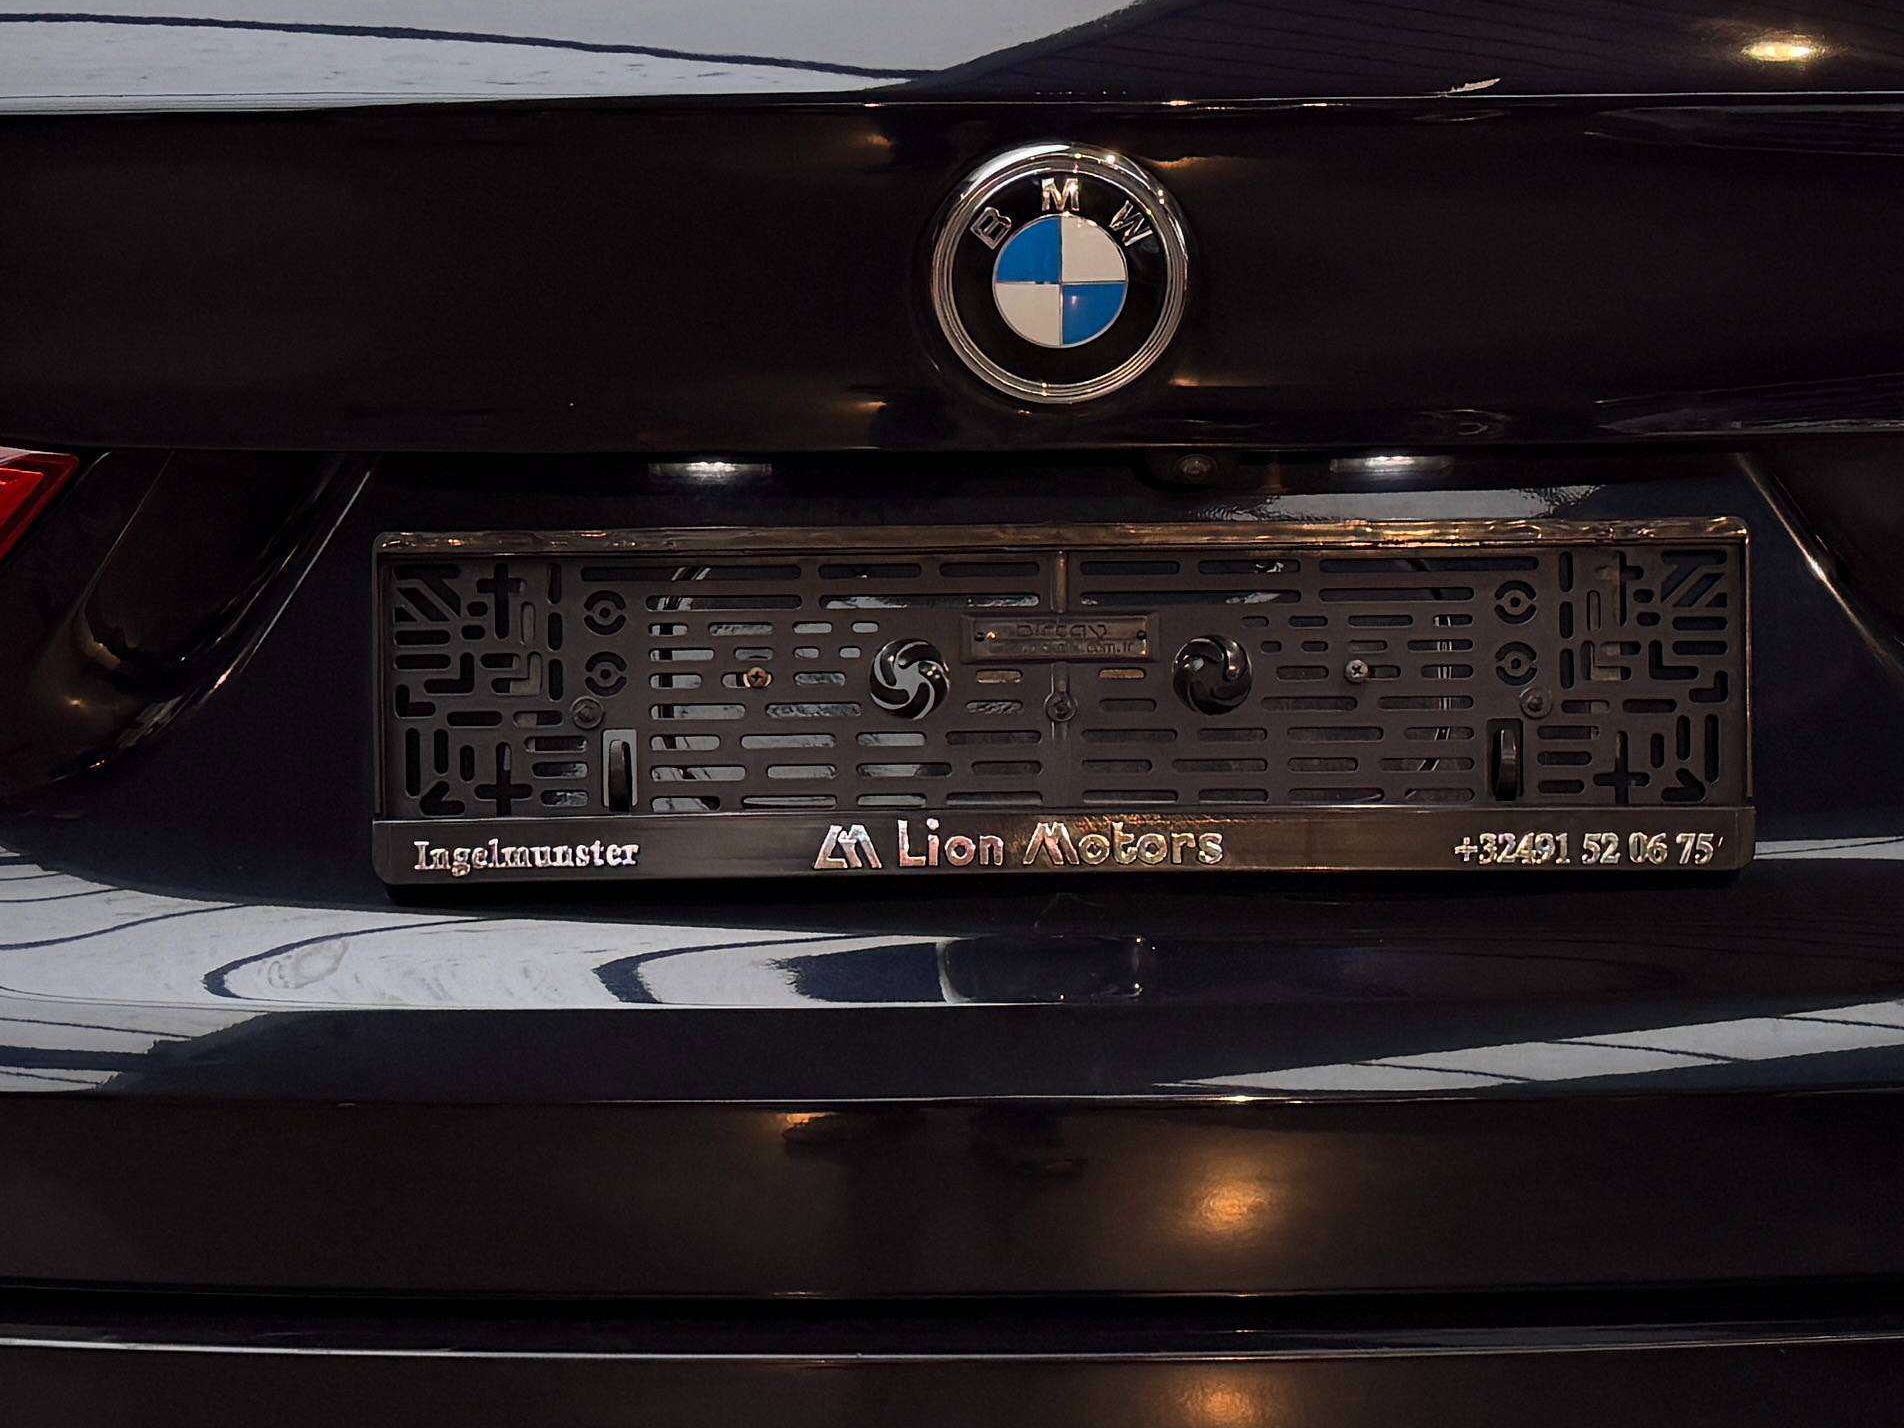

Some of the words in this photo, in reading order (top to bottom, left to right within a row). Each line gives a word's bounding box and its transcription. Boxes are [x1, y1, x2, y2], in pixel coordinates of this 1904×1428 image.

[969, 177, 1154, 250] BMW
[412, 837, 640, 878] Ingelmunster
[897, 817, 1005, 867] Lion
[1022, 820, 1225, 867] Motors
[1454, 831, 1572, 865] +32491
[1581, 831, 1622, 865] 52
[1627, 831, 1668, 865] 06
[1675, 832, 1715, 865] 75
